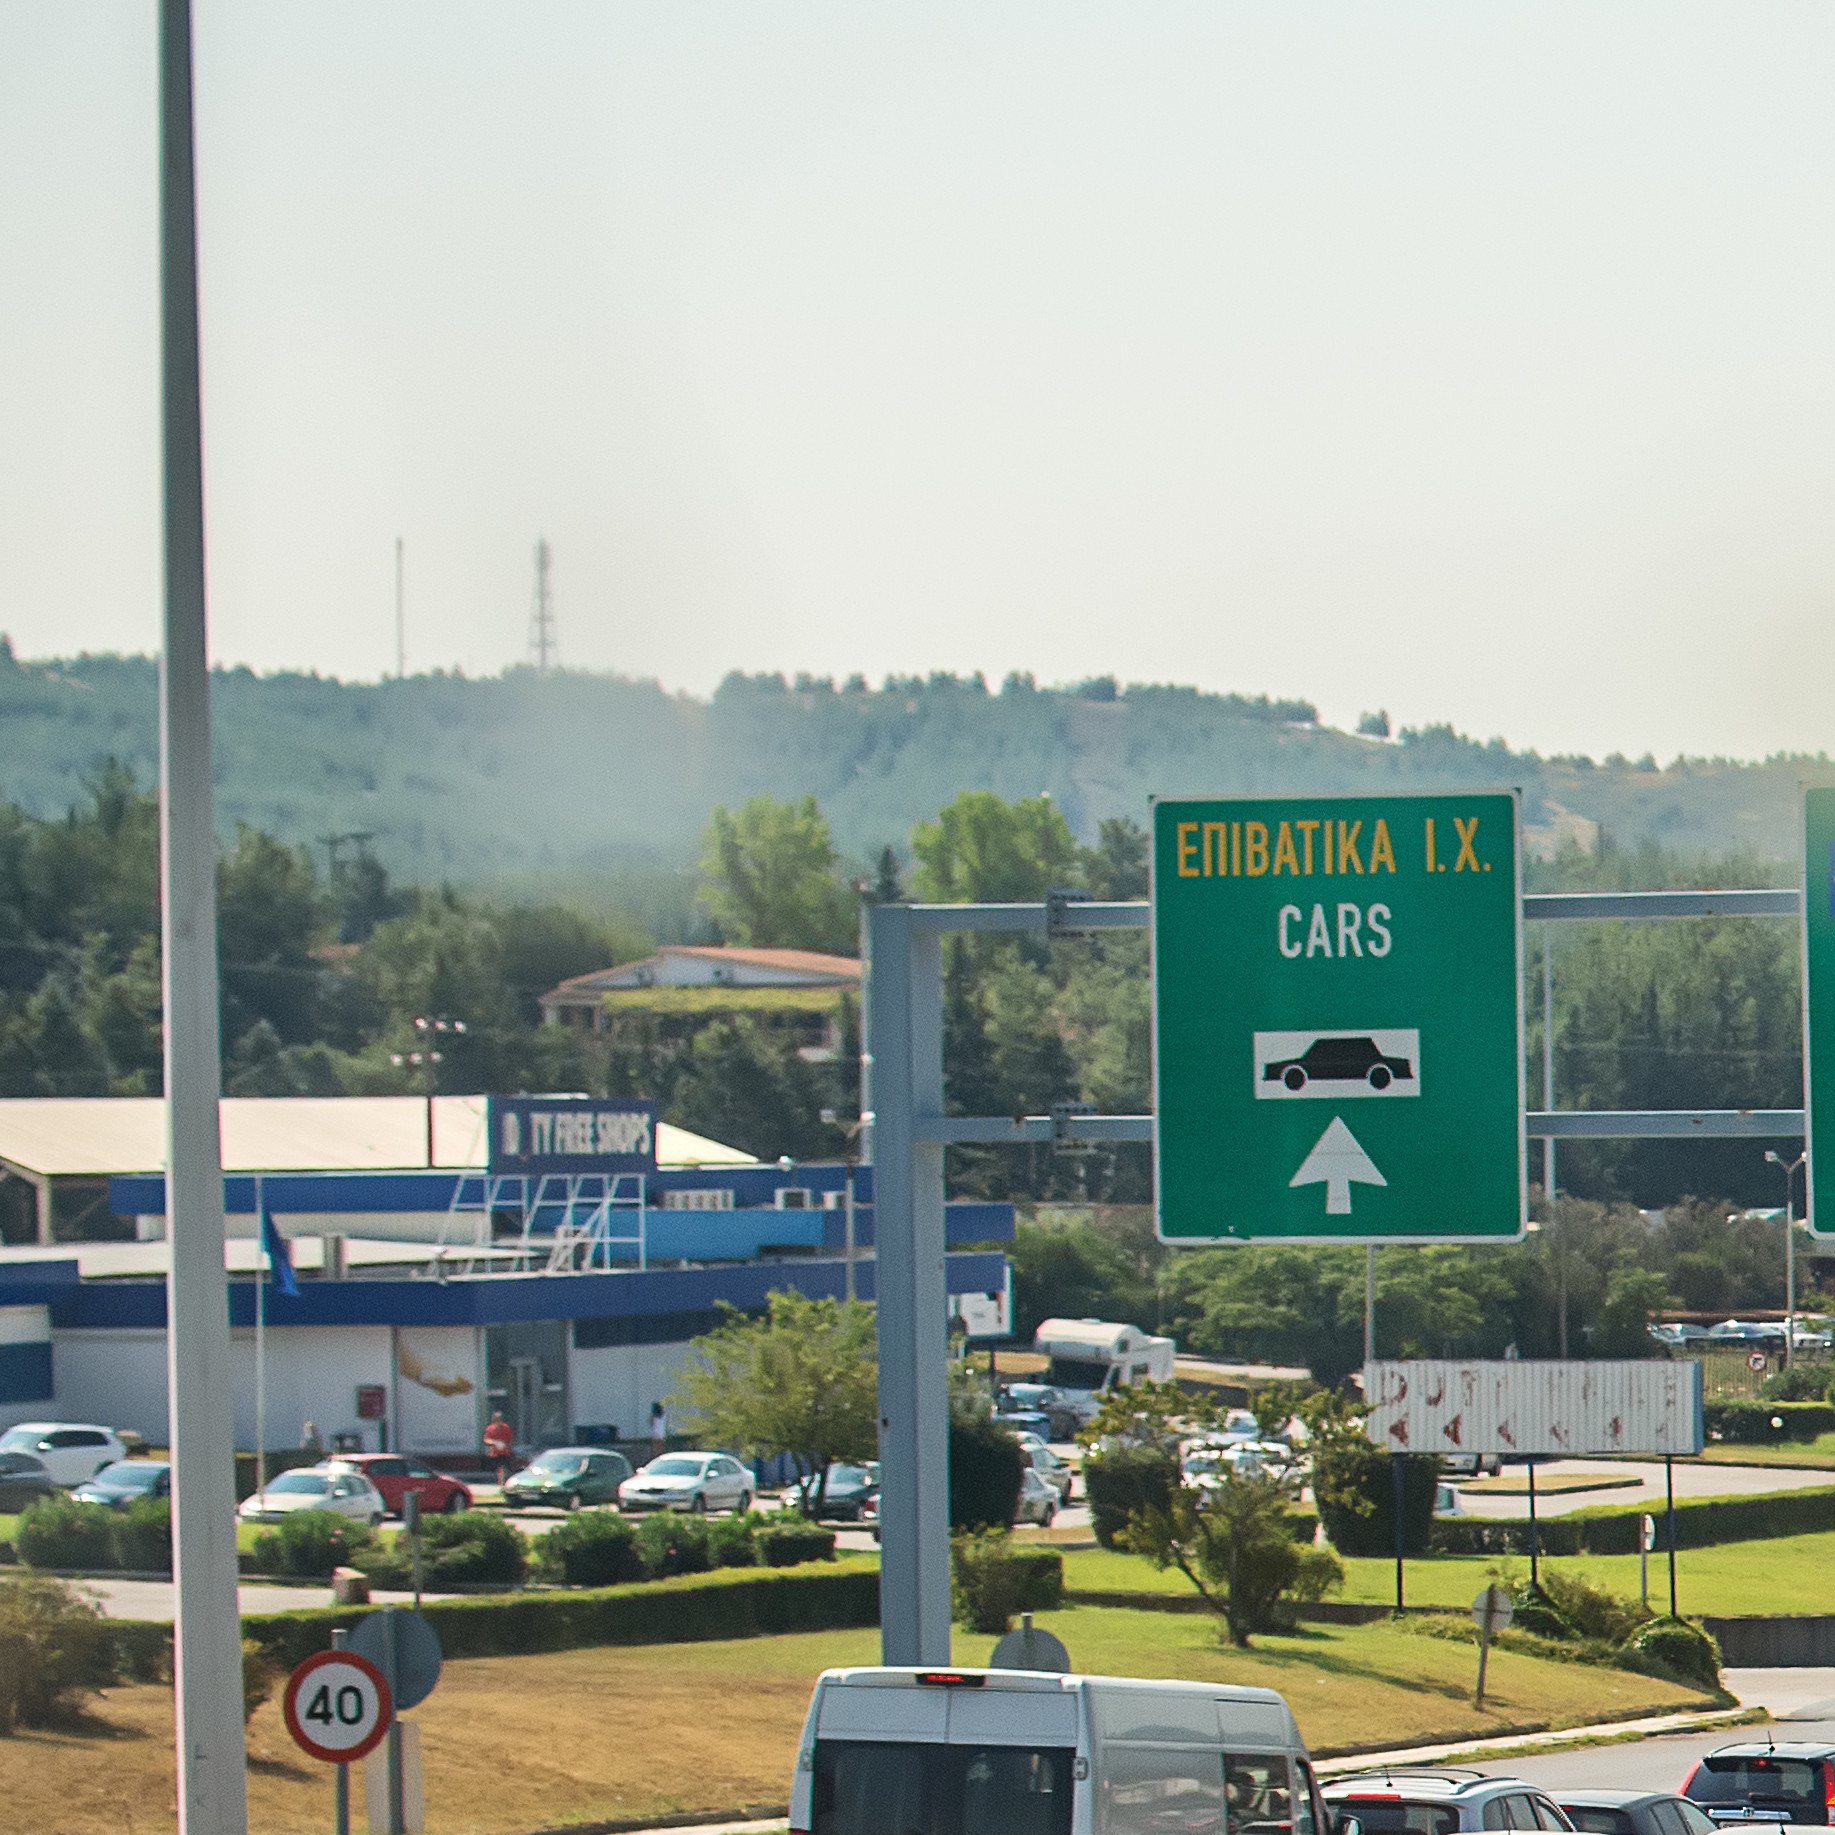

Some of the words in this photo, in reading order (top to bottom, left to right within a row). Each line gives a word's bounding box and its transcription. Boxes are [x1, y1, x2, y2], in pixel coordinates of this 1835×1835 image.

[1176, 818, 1397, 877] ΕΠΙΒΑΤΙΚΑ
[1278, 903, 1392, 958] CARS
[305, 1684, 364, 1725] 40
